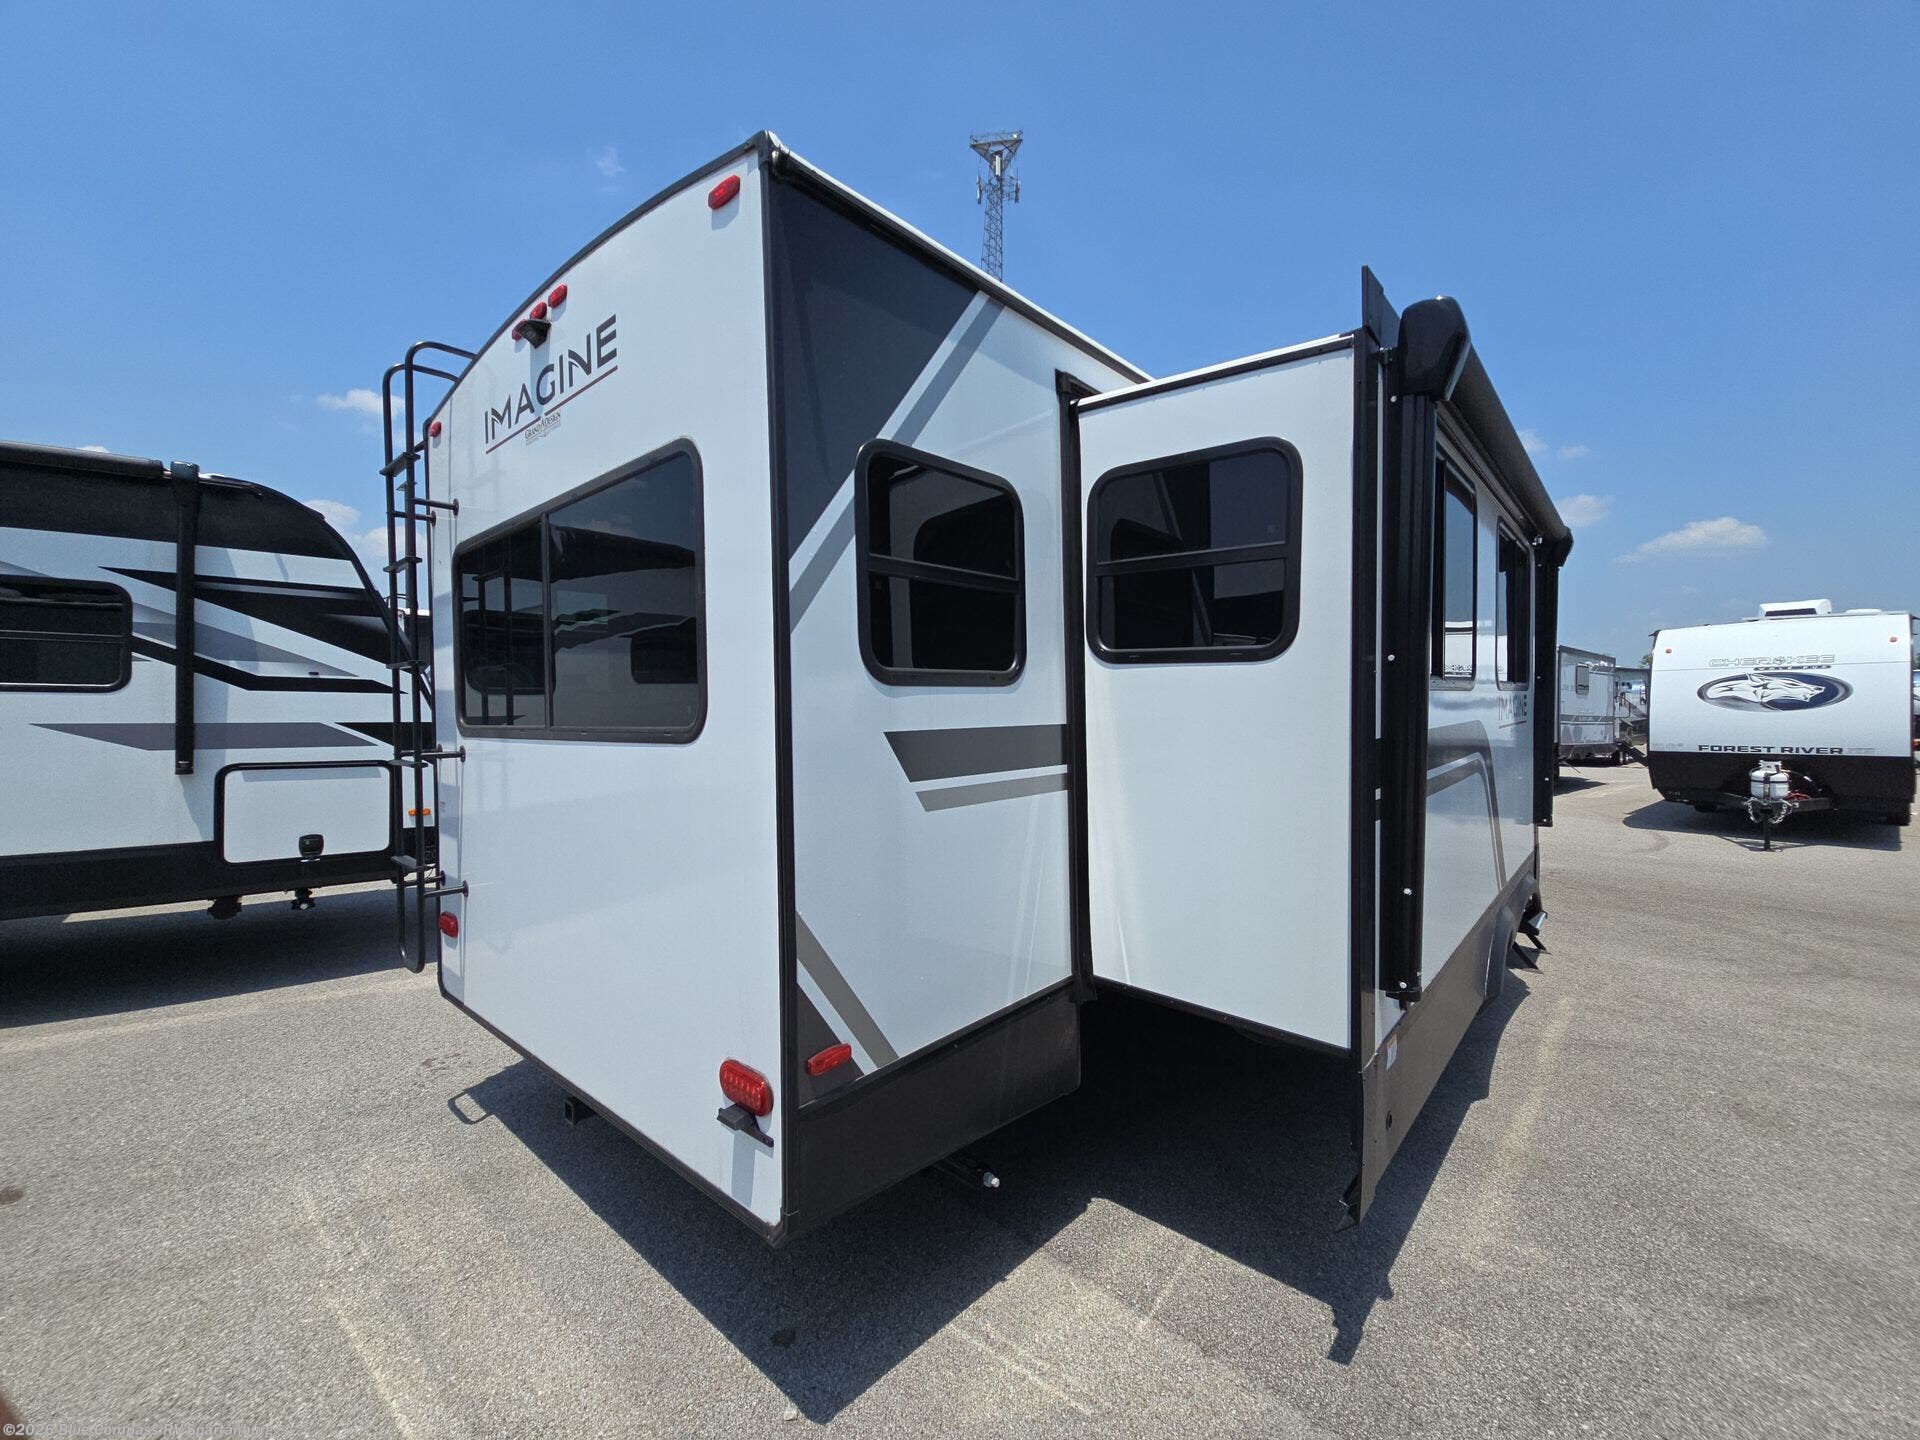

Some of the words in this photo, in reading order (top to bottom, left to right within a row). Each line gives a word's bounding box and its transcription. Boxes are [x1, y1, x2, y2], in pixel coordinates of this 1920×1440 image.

[484, 314, 617, 444] IMAGINE
[1708, 654, 1836, 667] CHEROKEE
[1698, 744, 1775, 753] FOREST
[1781, 746, 1843, 755] RIVER
